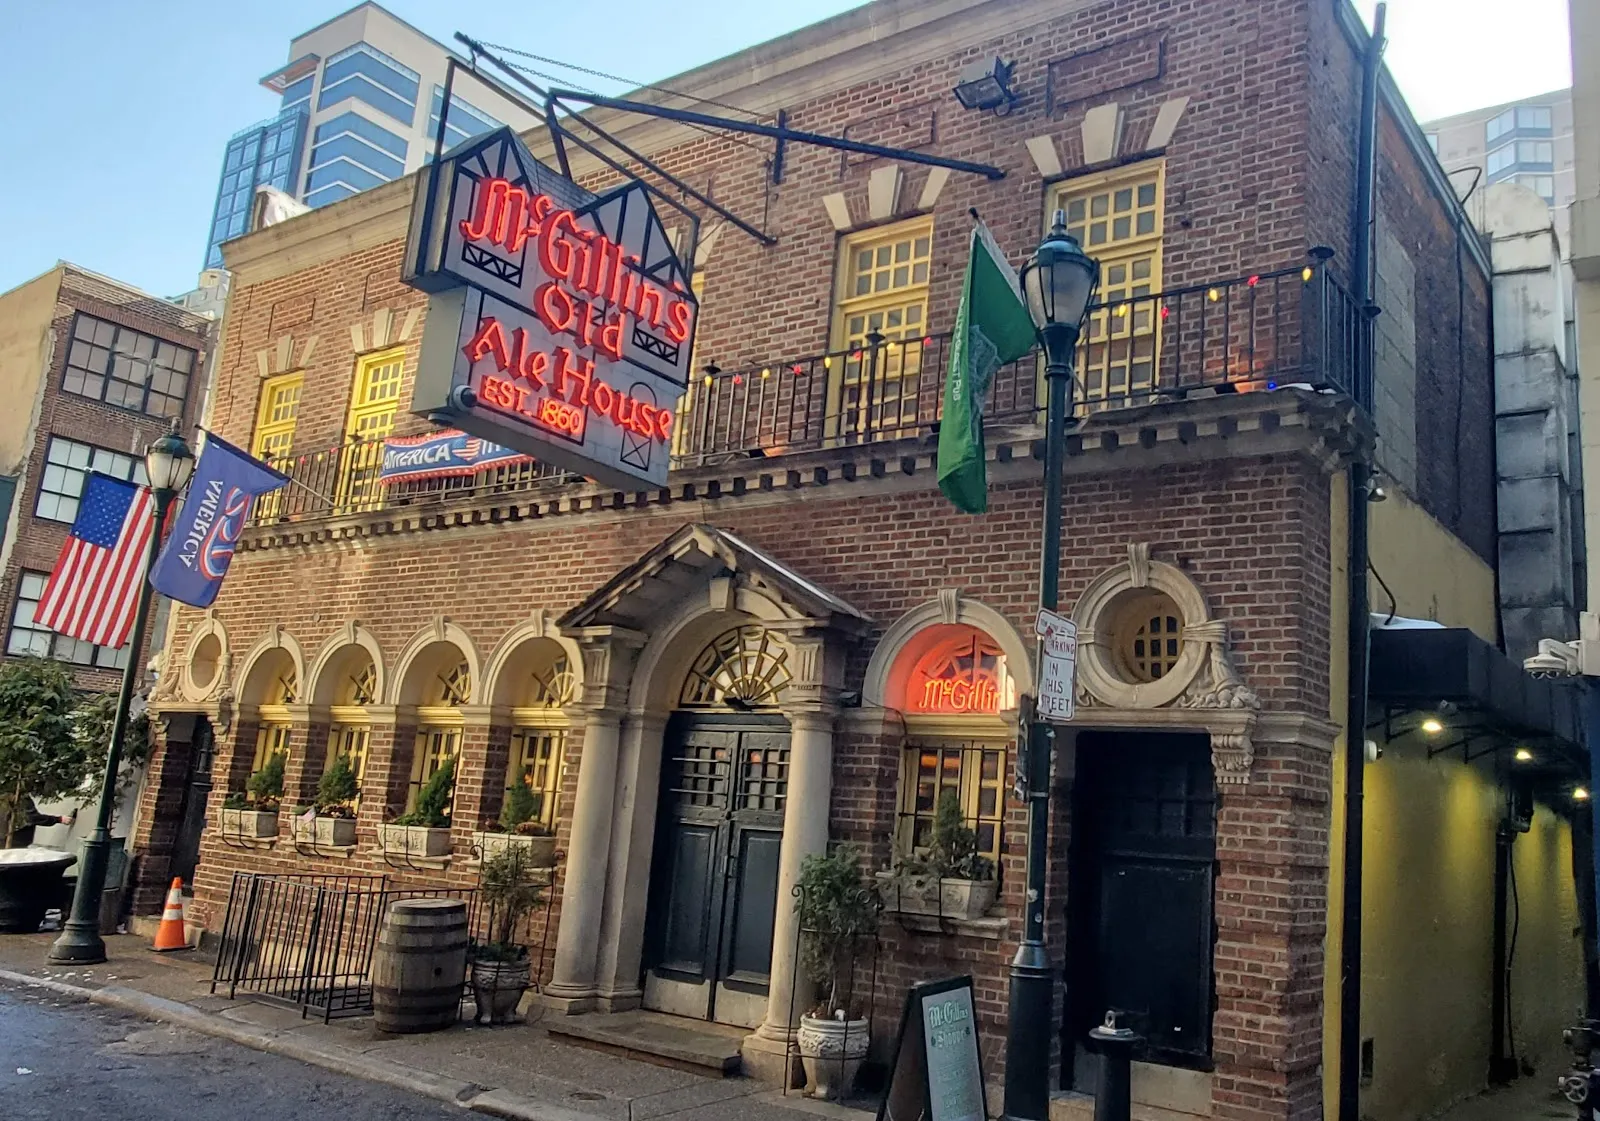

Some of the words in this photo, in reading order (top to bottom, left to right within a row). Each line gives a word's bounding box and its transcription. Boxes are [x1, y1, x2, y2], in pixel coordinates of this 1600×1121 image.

[534, 283, 626, 361] Old
[463, 317, 549, 392] Ale
[547, 346, 673, 441] House
[538, 398, 584, 434] 1860
[384, 443, 451, 470] AMERICA
[1049, 662, 1059, 676] IN
[1045, 678, 1063, 694] THIS
[1040, 694, 1070, 712] STREET
